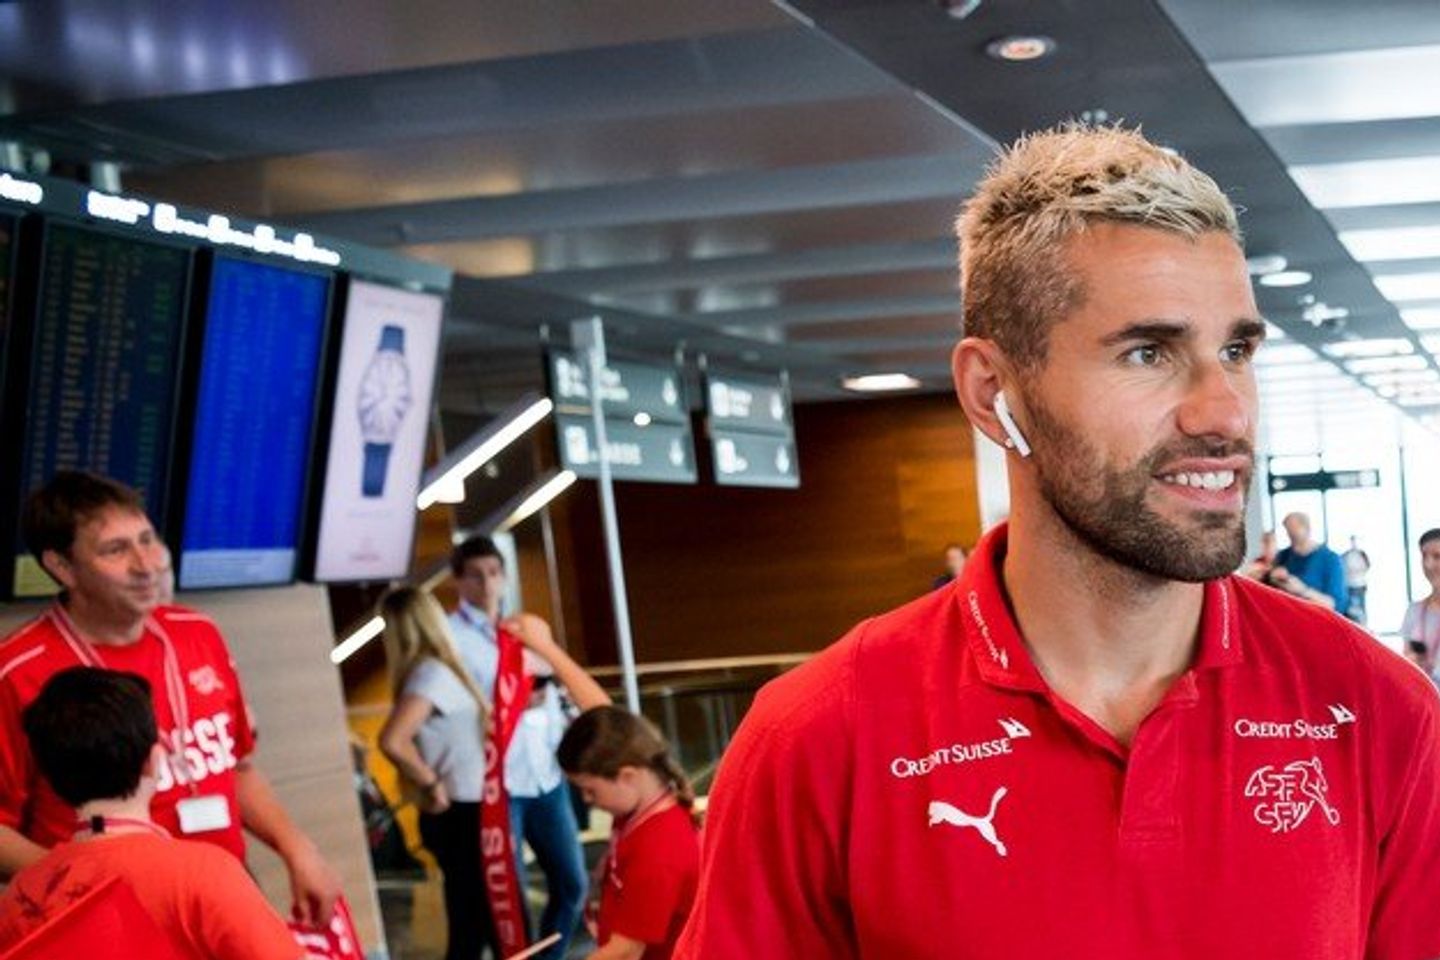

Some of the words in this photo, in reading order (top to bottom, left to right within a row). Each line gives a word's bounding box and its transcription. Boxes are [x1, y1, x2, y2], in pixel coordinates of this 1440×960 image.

[1234, 718, 1292, 738] CREDIT
[890, 749, 950, 778] CREDIT
[951, 737, 1013, 763] SUISSE
